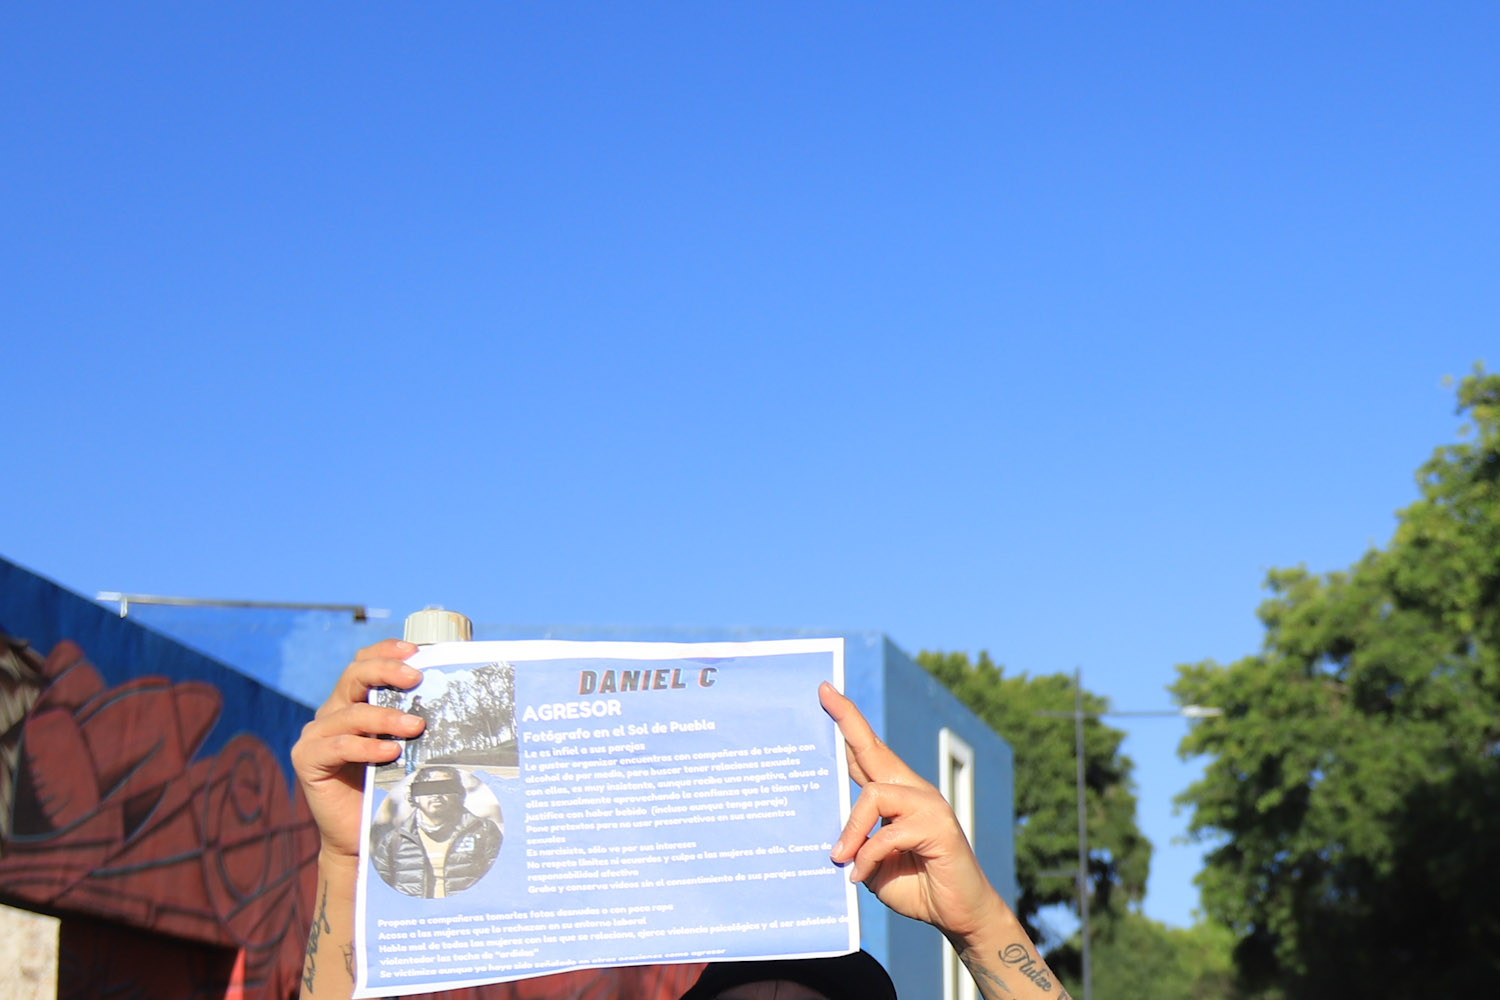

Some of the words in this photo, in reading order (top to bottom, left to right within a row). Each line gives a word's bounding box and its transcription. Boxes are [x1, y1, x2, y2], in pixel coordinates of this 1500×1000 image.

[579, 668, 687, 695] DANIEL
[698, 667, 719, 689] C
[522, 699, 622, 722] AGRESOR
[523, 728, 591, 743] Fotógrafo
[593, 729, 610, 738] en
[612, 725, 625, 736] el
[628, 723, 649, 735] Sol
[651, 722, 667, 733] de
[670, 720, 715, 732] Puebla
[524, 750, 537, 758] Le
[552, 746, 579, 755] infiel
[608, 742, 645, 754] parejas
[571, 759, 618, 769] organizar
[619, 755, 672, 764] encuentros
[692, 749, 749, 760] compañeras
[750, 747, 762, 755] de
[763, 744, 797, 754] trabajo
[525, 774, 560, 783] alcohol
[562, 773, 574, 781] de
[576, 773, 592, 781] por
[626, 770, 649, 778] para
[650, 768, 682, 776] buscar
[711, 762, 759, 771] relaciones
[760, 758, 800, 768] sexuales
[584, 785, 605, 793] muy
[657, 780, 691, 788] aunque
[743, 772, 786, 783] negativa,
[817, 768, 829, 776] de
[526, 800, 549, 808] ellas
[551, 797, 611, 807] sexualmente
[613, 792, 681, 804] aprovechando
[682, 791, 692, 799] la
[693, 789, 740, 798] confianza
[741, 788, 758, 796] que
[760, 785, 770, 793] le
[771, 784, 801, 792] tienen
[802, 784, 808, 792] y
[810, 781, 820, 789] lo
[525, 812, 565, 823] justifica
[585, 809, 613, 817] haber
[615, 807, 647, 816] bebido
[651, 805, 688, 816] (incluso
[689, 803, 724, 811] aunque
[725, 801, 753, 809] tenga
[754, 797, 788, 808] pareja)
[746, 810, 796, 819] encuentros
[526, 836, 566, 844] sexuales
[588, 846, 607, 854] sólo
[656, 842, 696, 850] intereses
[620, 856, 662, 864] acuerdos
[663, 856, 669, 864] y
[671, 853, 696, 862] culpa
[719, 849, 754, 858] mujeres
[755, 847, 766, 855] de
[821, 842, 832, 850] de
[528, 871, 599, 882] responsabilidad
[600, 869, 639, 877] afectiva
[528, 885, 556, 893] Graba
[666, 875, 733, 886] consentimiento
[735, 873, 746, 881] de
[764, 870, 796, 880] parejas
[798, 867, 836, 876] sexuales
[378, 920, 417, 928] Propone
[427, 915, 484, 925] compañeras
[486, 912, 528, 920] tomarles
[628, 906, 651, 914] poca
[652, 904, 674, 912] ropa
[379, 944, 407, 952] Habla
[408, 943, 427, 951] mal
[428, 942, 440, 950] de
[442, 941, 469, 949] todas
[486, 938, 523, 947] mujeres
[543, 935, 557, 943] las
[559, 935, 576, 943] que
[637, 929, 665, 938] ejerce
[667, 926, 708, 935] violencia
[769, 920, 778, 928] al
[433, 928, 471, 938] mujeres
[472, 928, 490, 936] que
[491, 925, 501, 933] lo
[503, 924, 547, 932] rechazan
[380, 956, 436, 965] violentador
[453, 953, 480, 961] tacha
